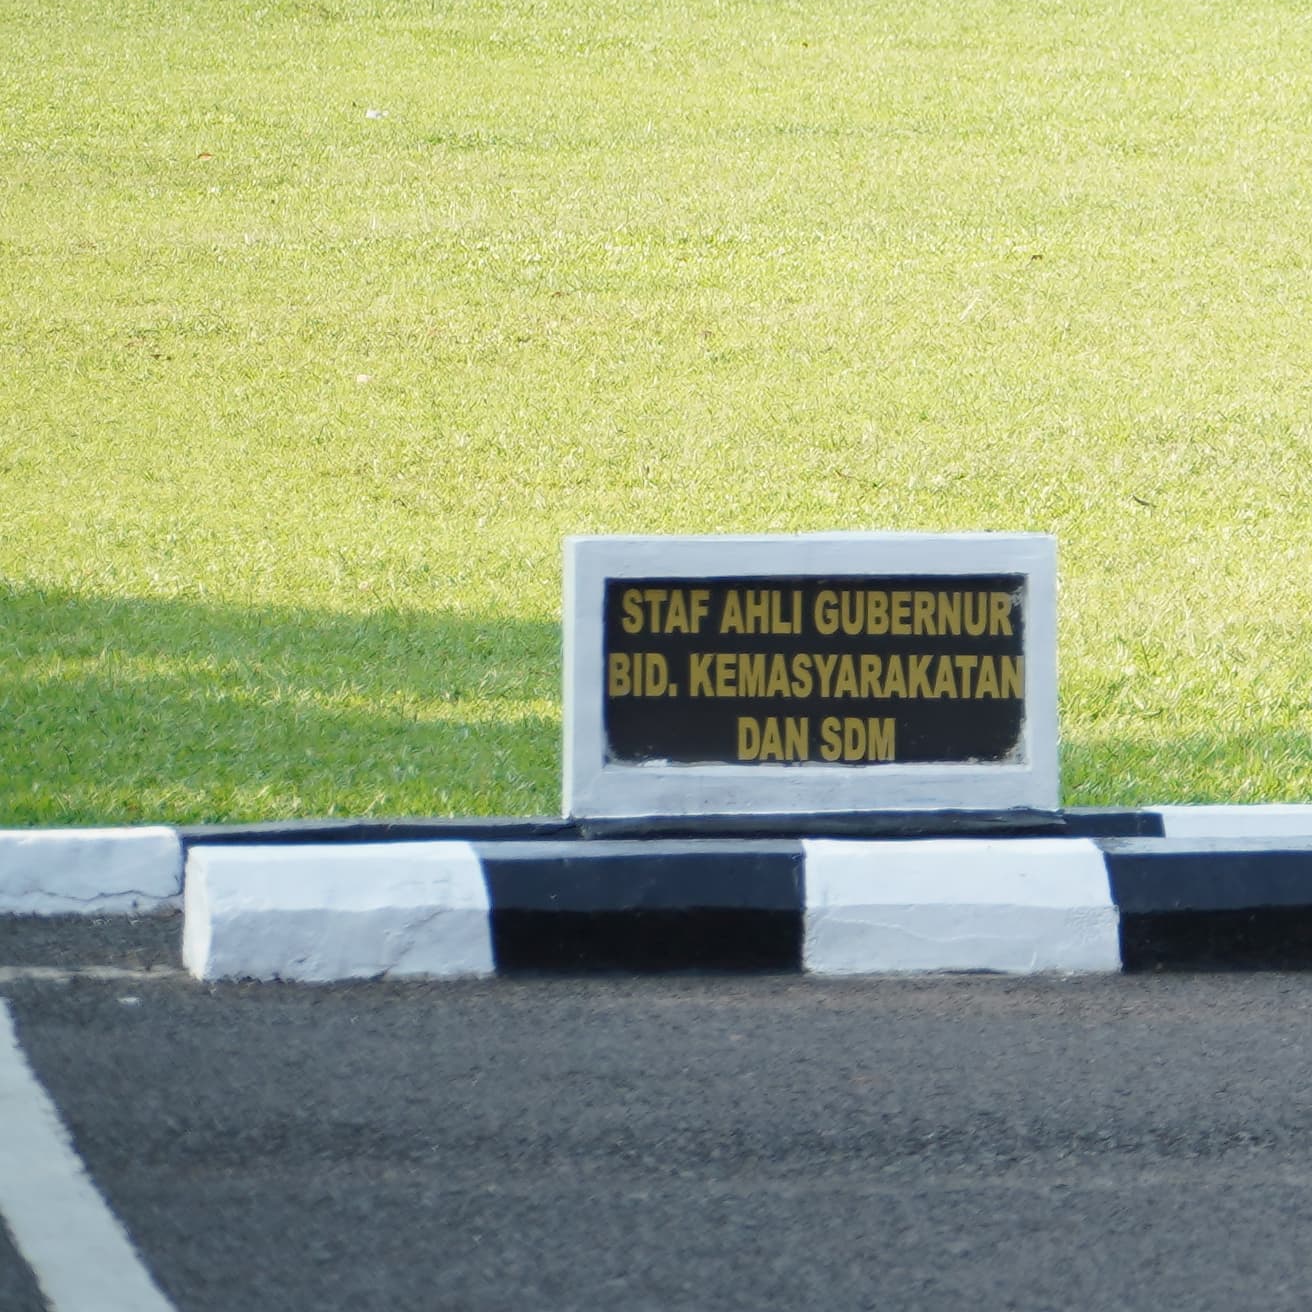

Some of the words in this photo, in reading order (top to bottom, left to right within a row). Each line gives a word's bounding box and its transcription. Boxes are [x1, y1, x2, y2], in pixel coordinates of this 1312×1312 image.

[622, 590, 710, 634] STAF
[720, 590, 800, 634] AHLI
[814, 590, 1013, 636] GUBERNUR
[608, 652, 678, 697] BID.
[690, 653, 1024, 700] KEMASYARAKATAN
[738, 717, 809, 761] DAN
[820, 717, 896, 761] SDM
